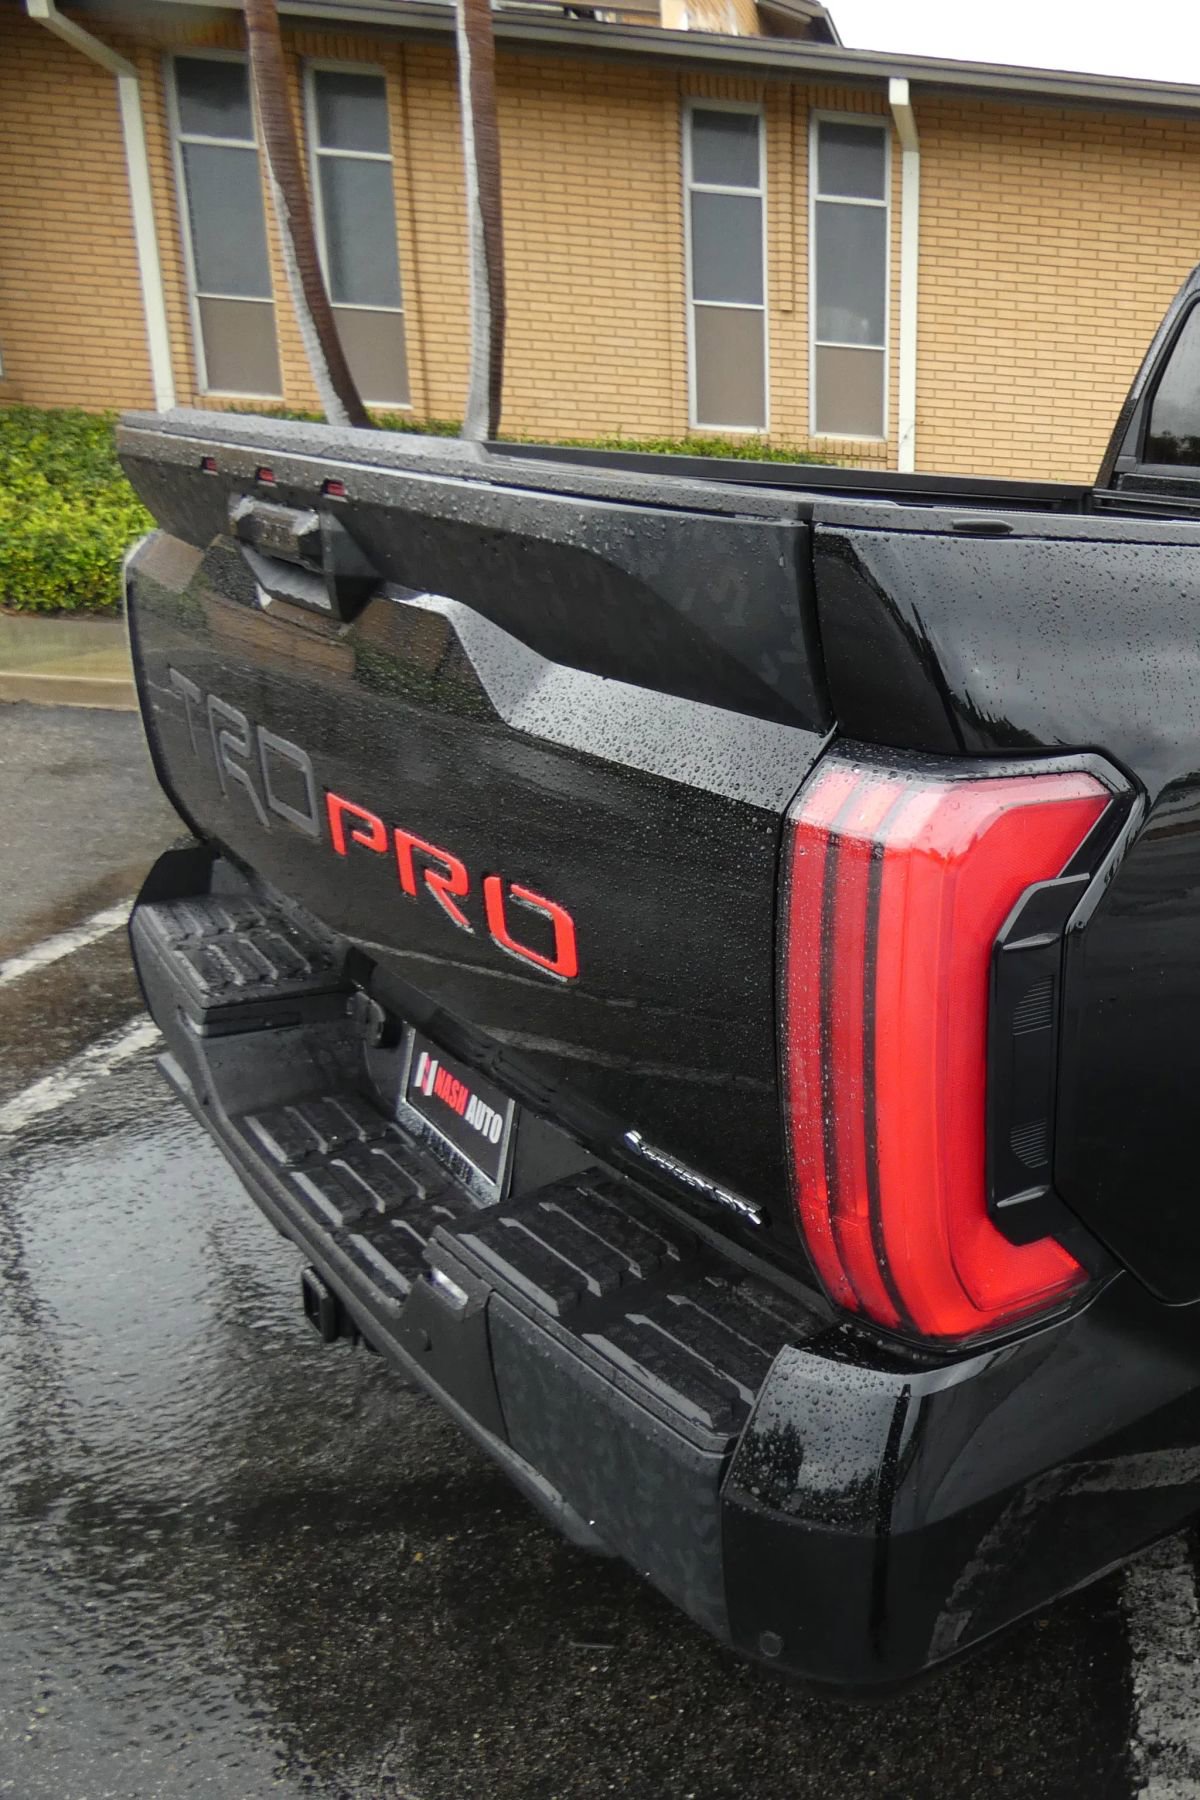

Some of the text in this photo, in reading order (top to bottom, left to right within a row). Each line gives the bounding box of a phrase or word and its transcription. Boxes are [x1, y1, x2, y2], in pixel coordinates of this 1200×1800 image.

[169, 667, 579, 979] TRD PRO
[434, 1066, 469, 1116] NASH
[465, 1094, 503, 1144] AUTO
